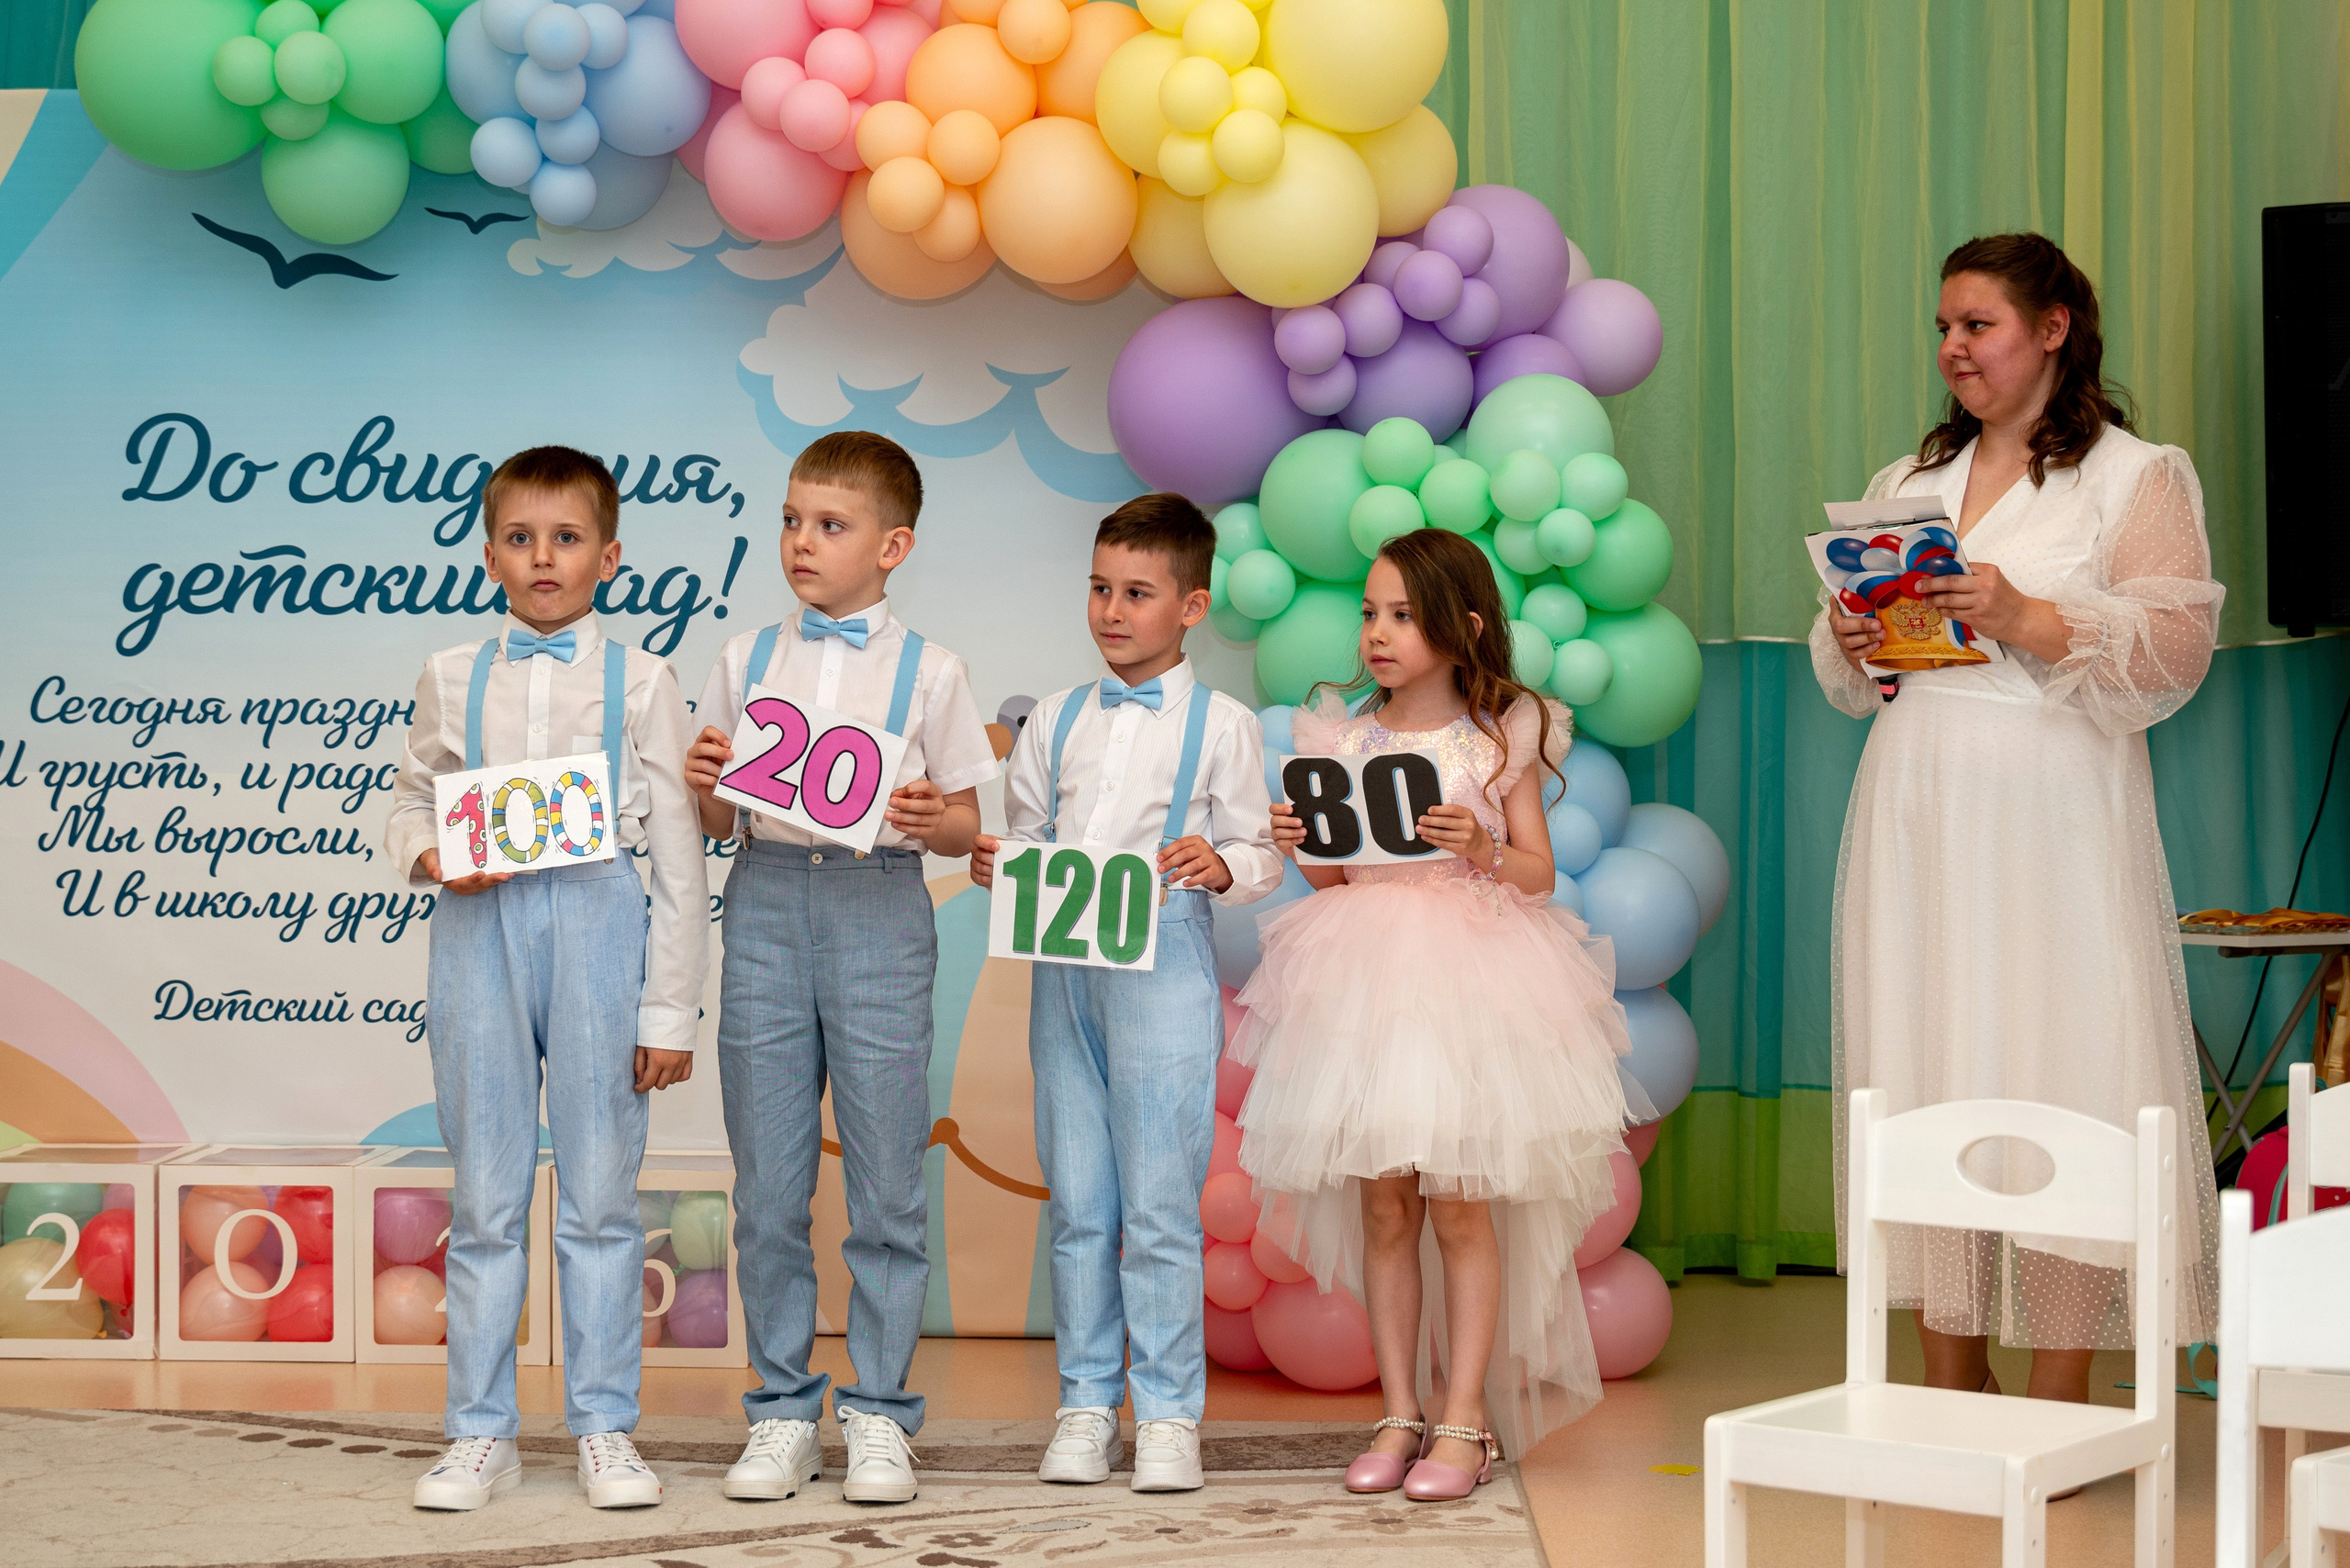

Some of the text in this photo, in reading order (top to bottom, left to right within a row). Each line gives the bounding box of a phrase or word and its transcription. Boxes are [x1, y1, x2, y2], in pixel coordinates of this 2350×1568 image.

[122, 412, 745, 548] До свидия,
[591, 536, 749, 657] ад!
[30, 676, 416, 750] Сегодня праздн
[39, 751, 221, 812] грусть,
[241, 762, 278, 790] и
[277, 762, 400, 814] радо
[720, 698, 883, 829] 20
[1282, 752, 1445, 859] 80
[38, 804, 374, 878] Мы выросли,
[446, 770, 605, 869] 100
[55, 868, 436, 945] И в школу дру
[1002, 847, 1151, 965] 120
[153, 979, 354, 1023] Детский
[26, 1212, 84, 1301] 2
